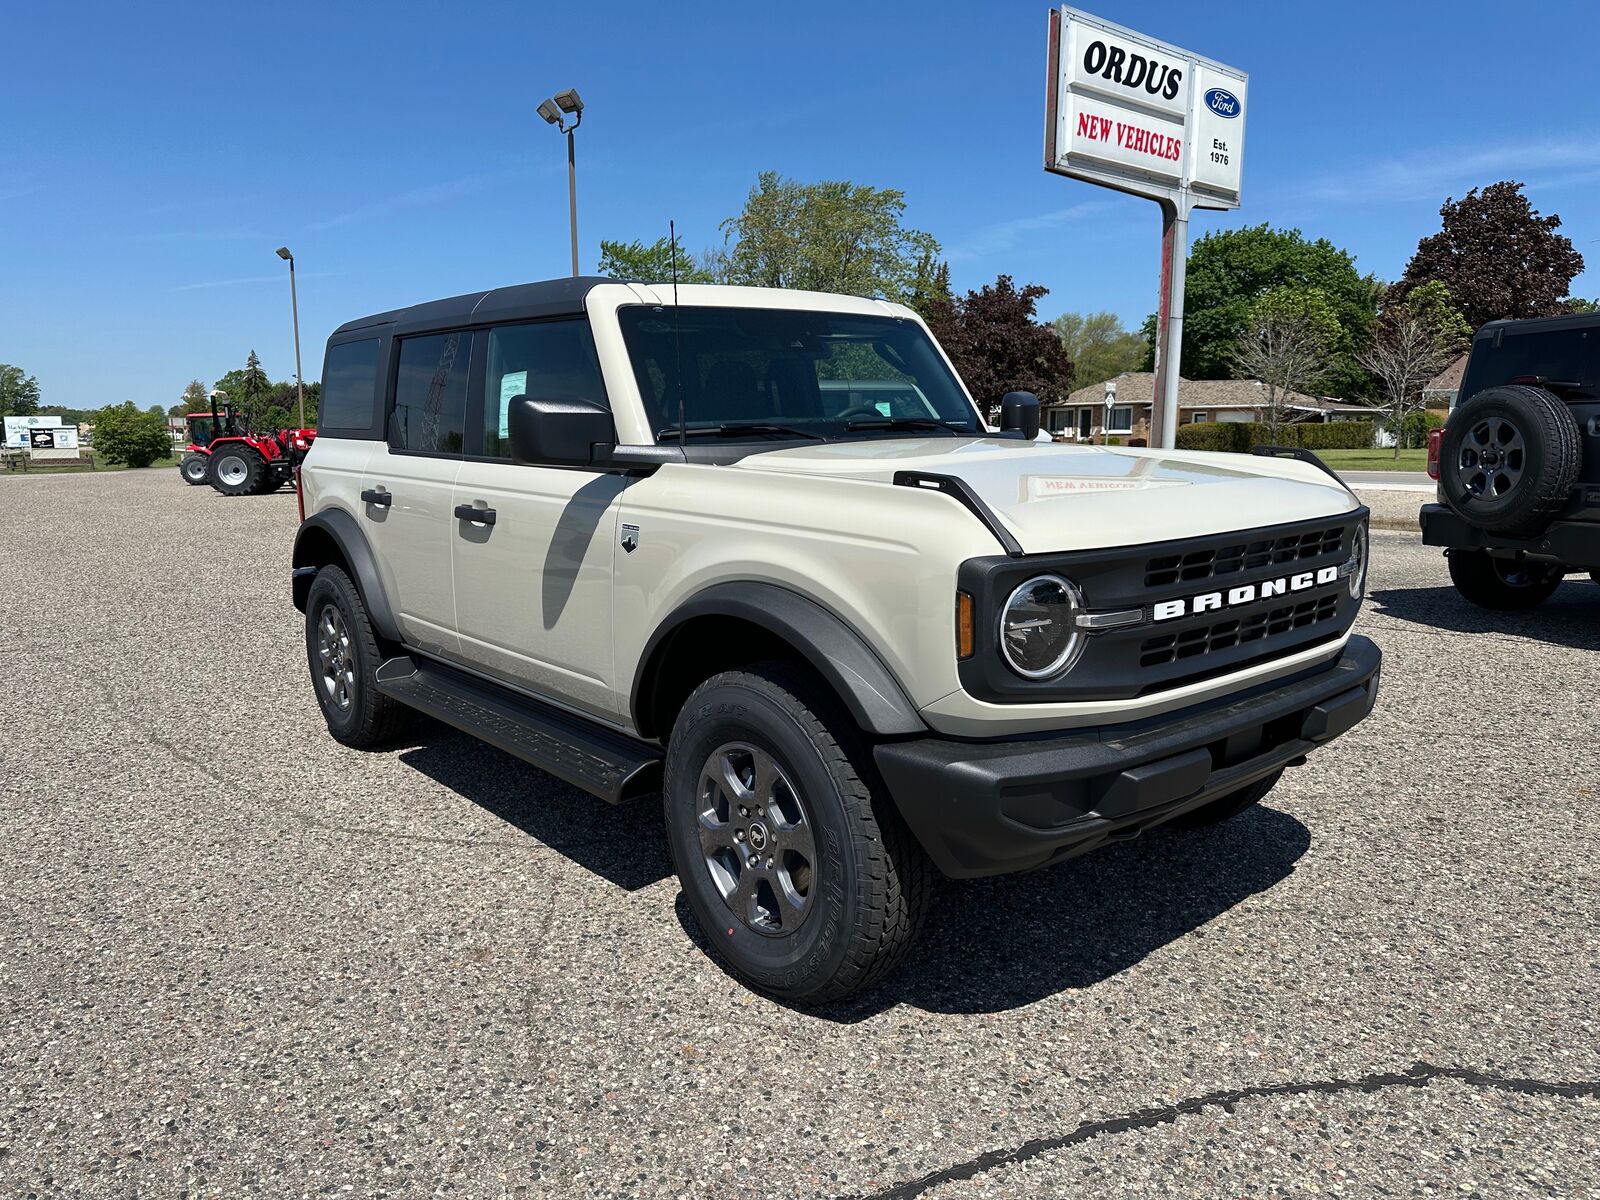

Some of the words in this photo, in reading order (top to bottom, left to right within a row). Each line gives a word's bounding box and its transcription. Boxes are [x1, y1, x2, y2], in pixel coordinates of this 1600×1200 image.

[1084, 41, 1182, 100] ORDUS
[1212, 92, 1234, 113] Ford
[1077, 113, 1112, 142] NEW
[1117, 123, 1180, 161] VEHICLES
[1213, 138, 1228, 152] Est.
[1210, 151, 1229, 166] 1976
[1153, 566, 1338, 621] BRONCO
